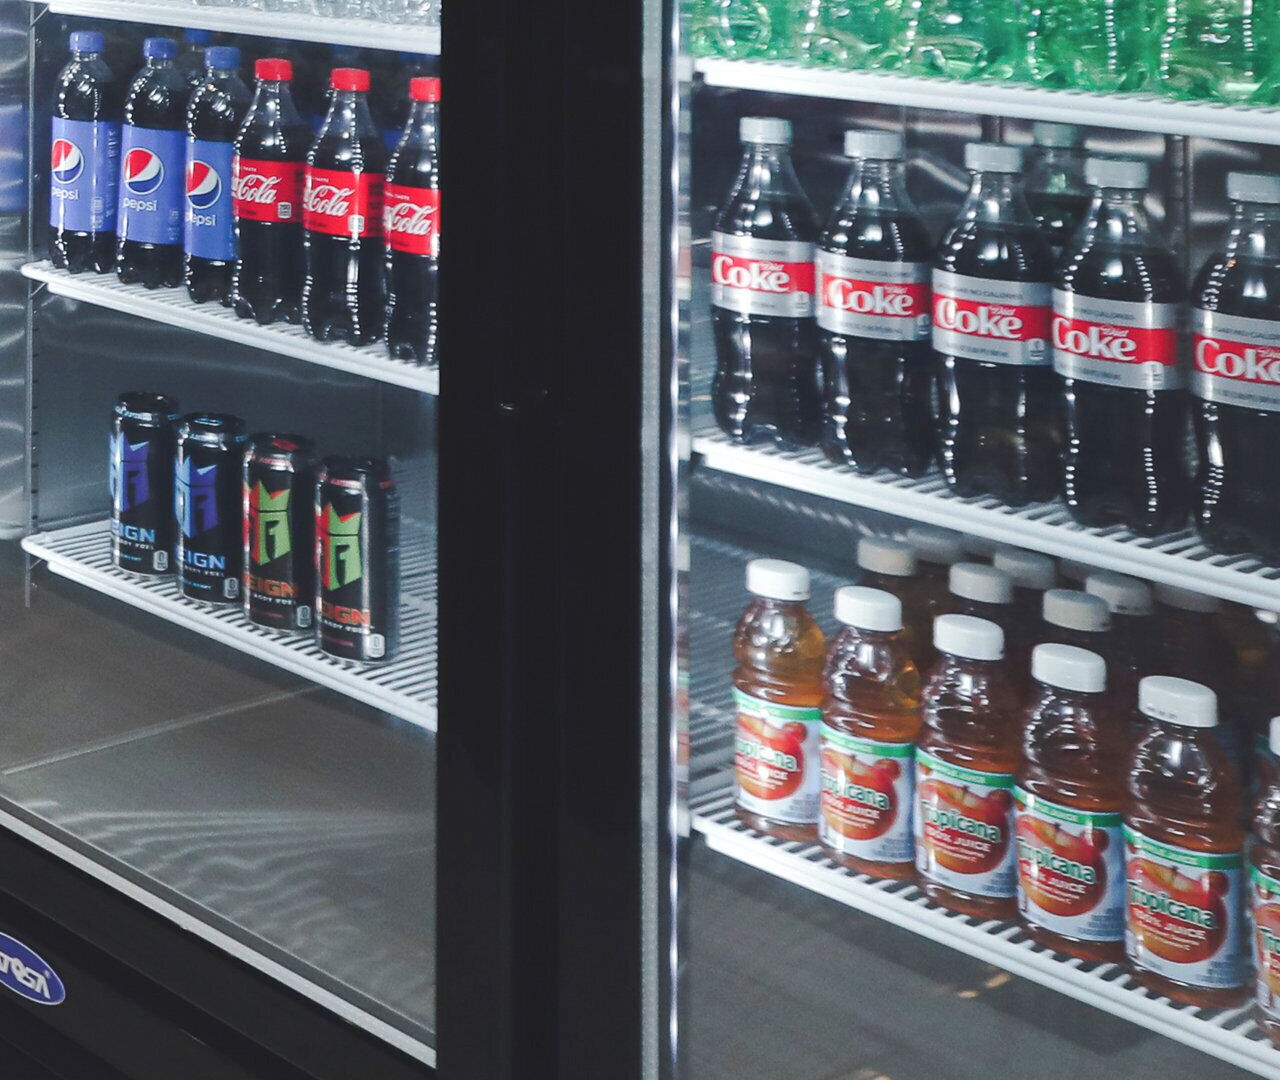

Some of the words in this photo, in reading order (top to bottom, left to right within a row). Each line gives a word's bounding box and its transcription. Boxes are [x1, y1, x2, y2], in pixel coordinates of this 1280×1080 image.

[52, 186, 79, 200] pepsi
[122, 198, 158, 213] pepsi
[713, 255, 791, 293] Coke
[827, 278, 914, 316] Coke
[936, 297, 1023, 339] Coke
[1052, 316, 1137, 361] Coke
[846, 804, 881, 820] JUICE
[921, 799, 1001, 845] Tropicana
[953, 837, 992, 853] JUICE
[1016, 836, 1097, 886] Tropicana
[1047, 877, 1088, 895] JUICE
[1127, 879, 1216, 930] Tropicana
[1164, 923, 1207, 941] JUICE
